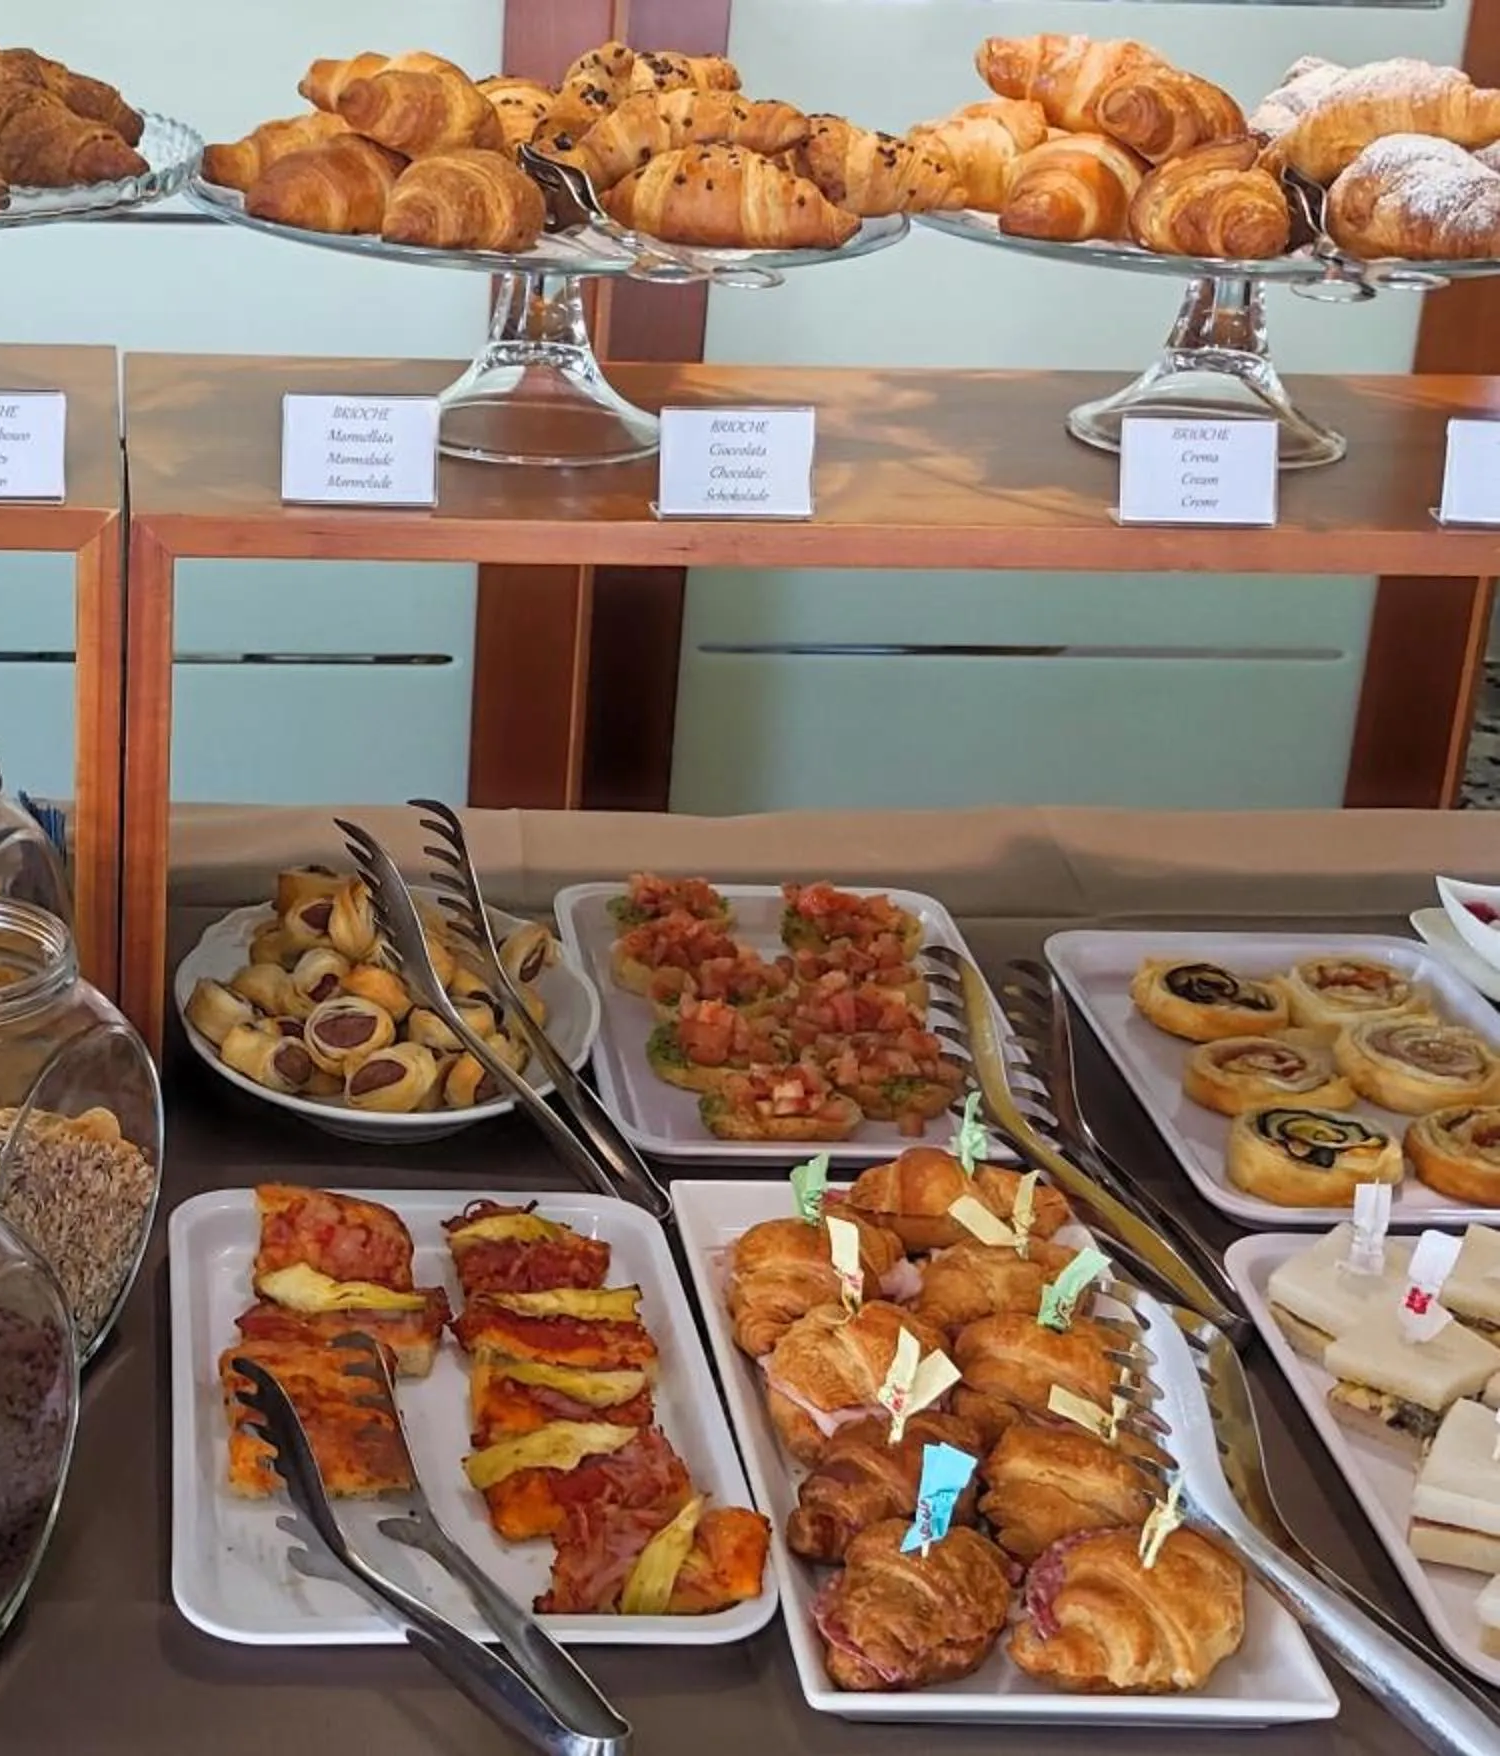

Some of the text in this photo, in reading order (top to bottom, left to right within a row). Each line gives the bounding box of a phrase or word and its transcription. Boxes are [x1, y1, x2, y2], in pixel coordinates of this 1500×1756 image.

[331, 405, 392, 421] BRIOCHE
[709, 419, 770, 434] BRIOCHE
[1171, 426, 1232, 441] BRIOCHE
[327, 428, 394, 444] Marmellata
[1180, 450, 1220, 464] Crema
[708, 465, 767, 480] Chocolate
[1180, 471, 1220, 486] Cream
[707, 486, 770, 503] Schokolade
